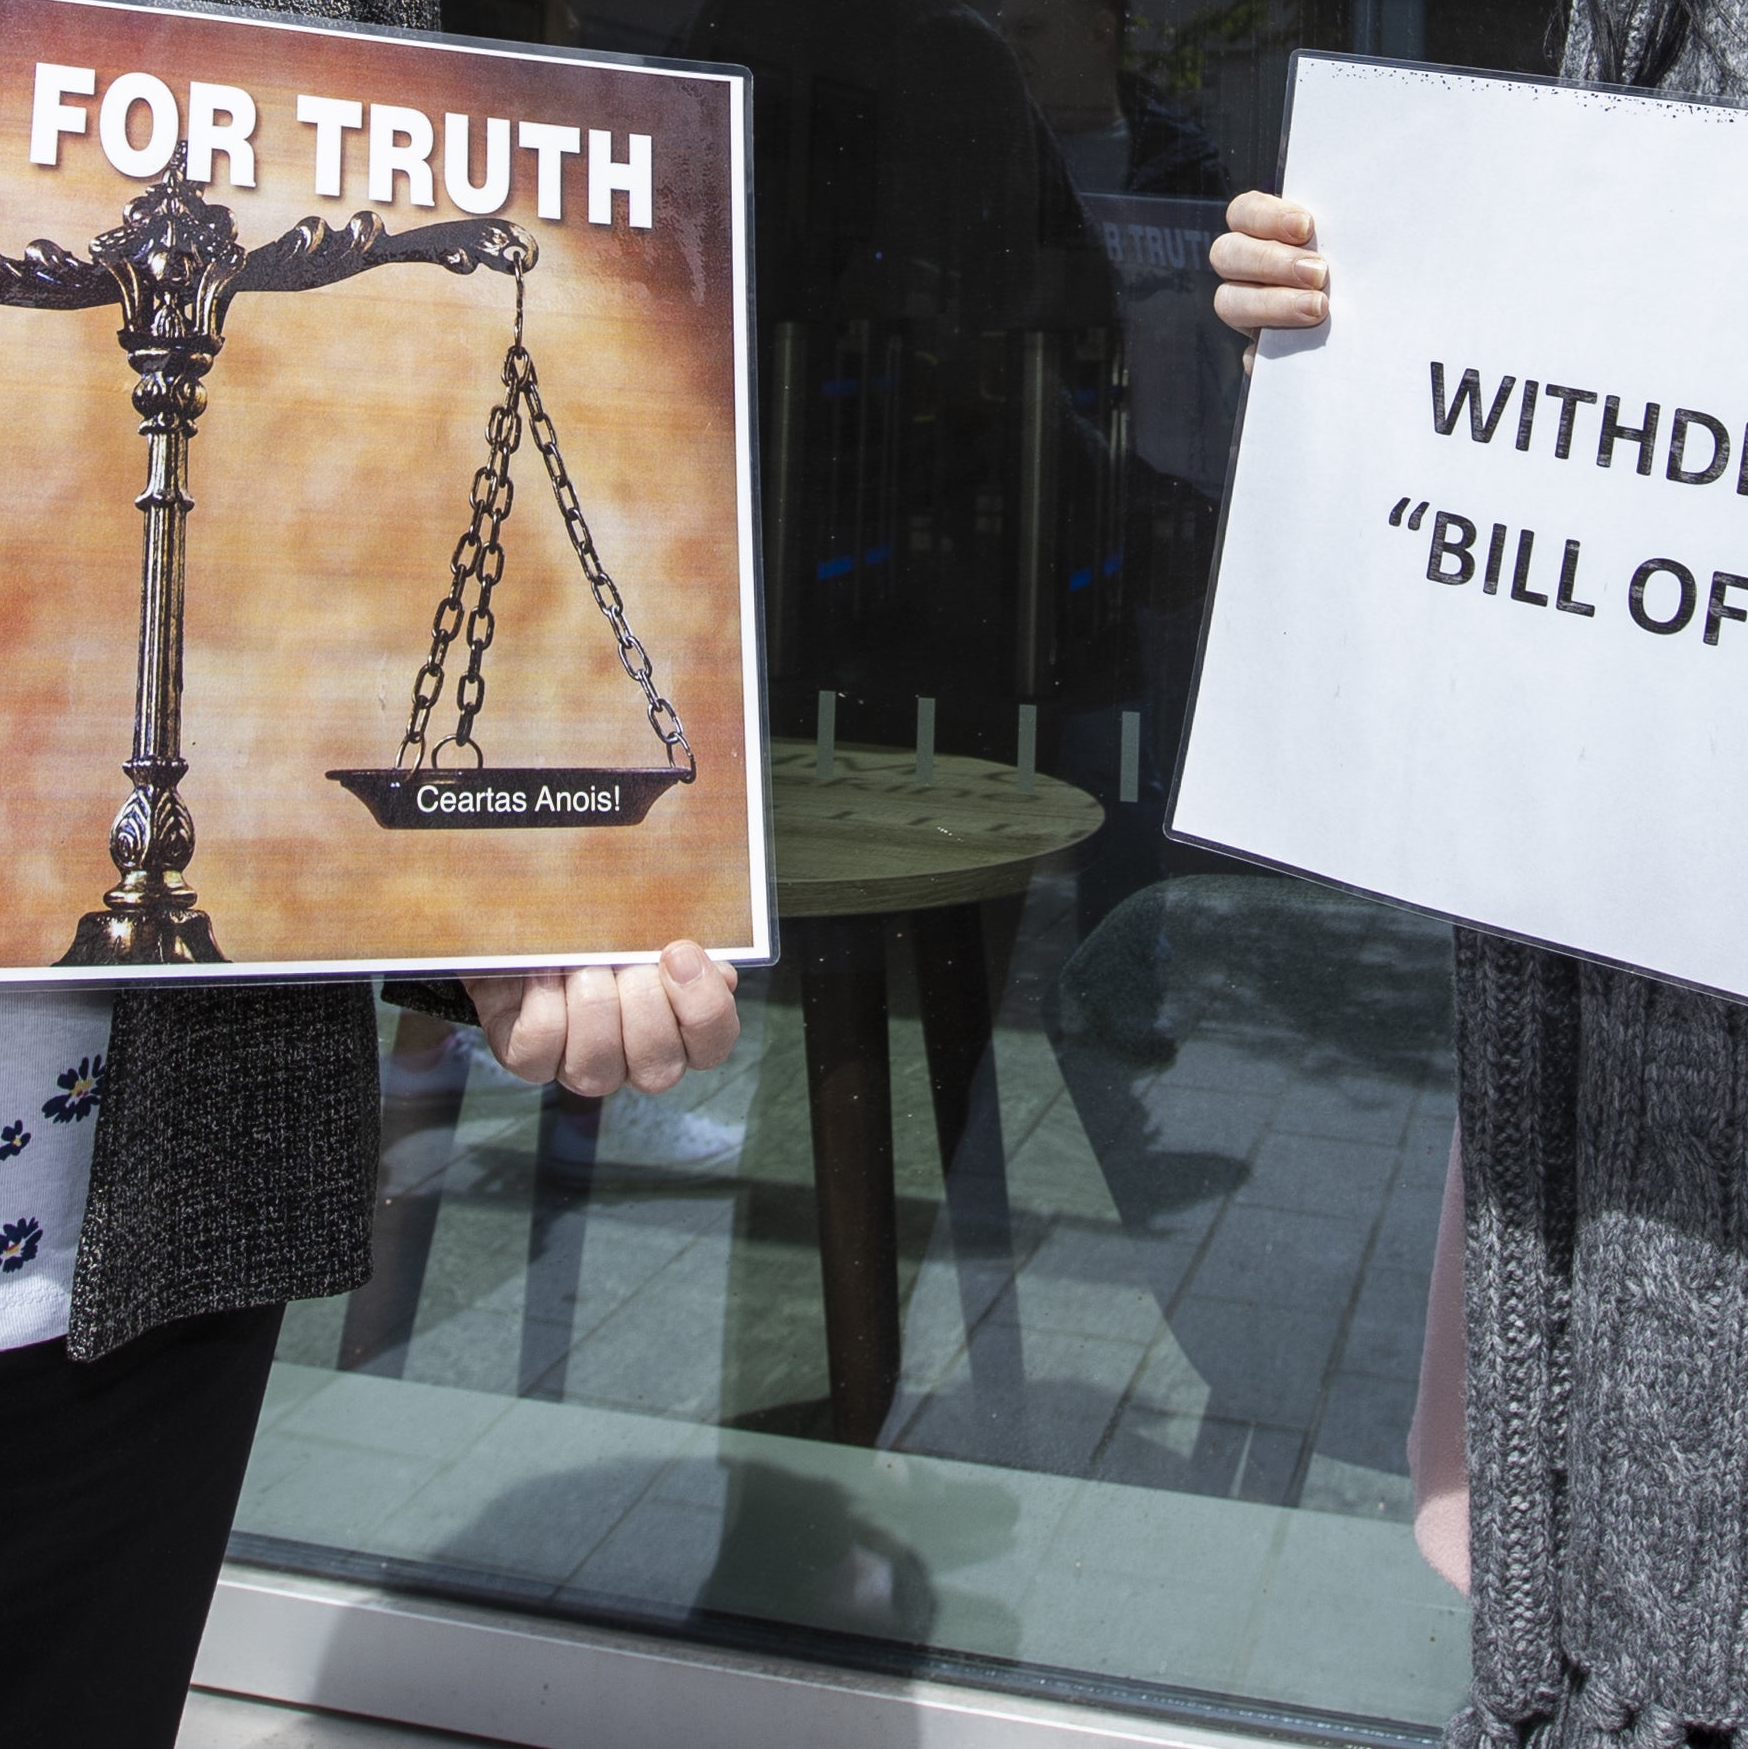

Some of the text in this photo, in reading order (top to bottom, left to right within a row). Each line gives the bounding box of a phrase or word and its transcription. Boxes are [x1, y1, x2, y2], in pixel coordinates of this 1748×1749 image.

[29, 62, 257, 188] FOR
[295, 94, 652, 229] TRUTH
[416, 783, 621, 814] Ceartas Anois!
